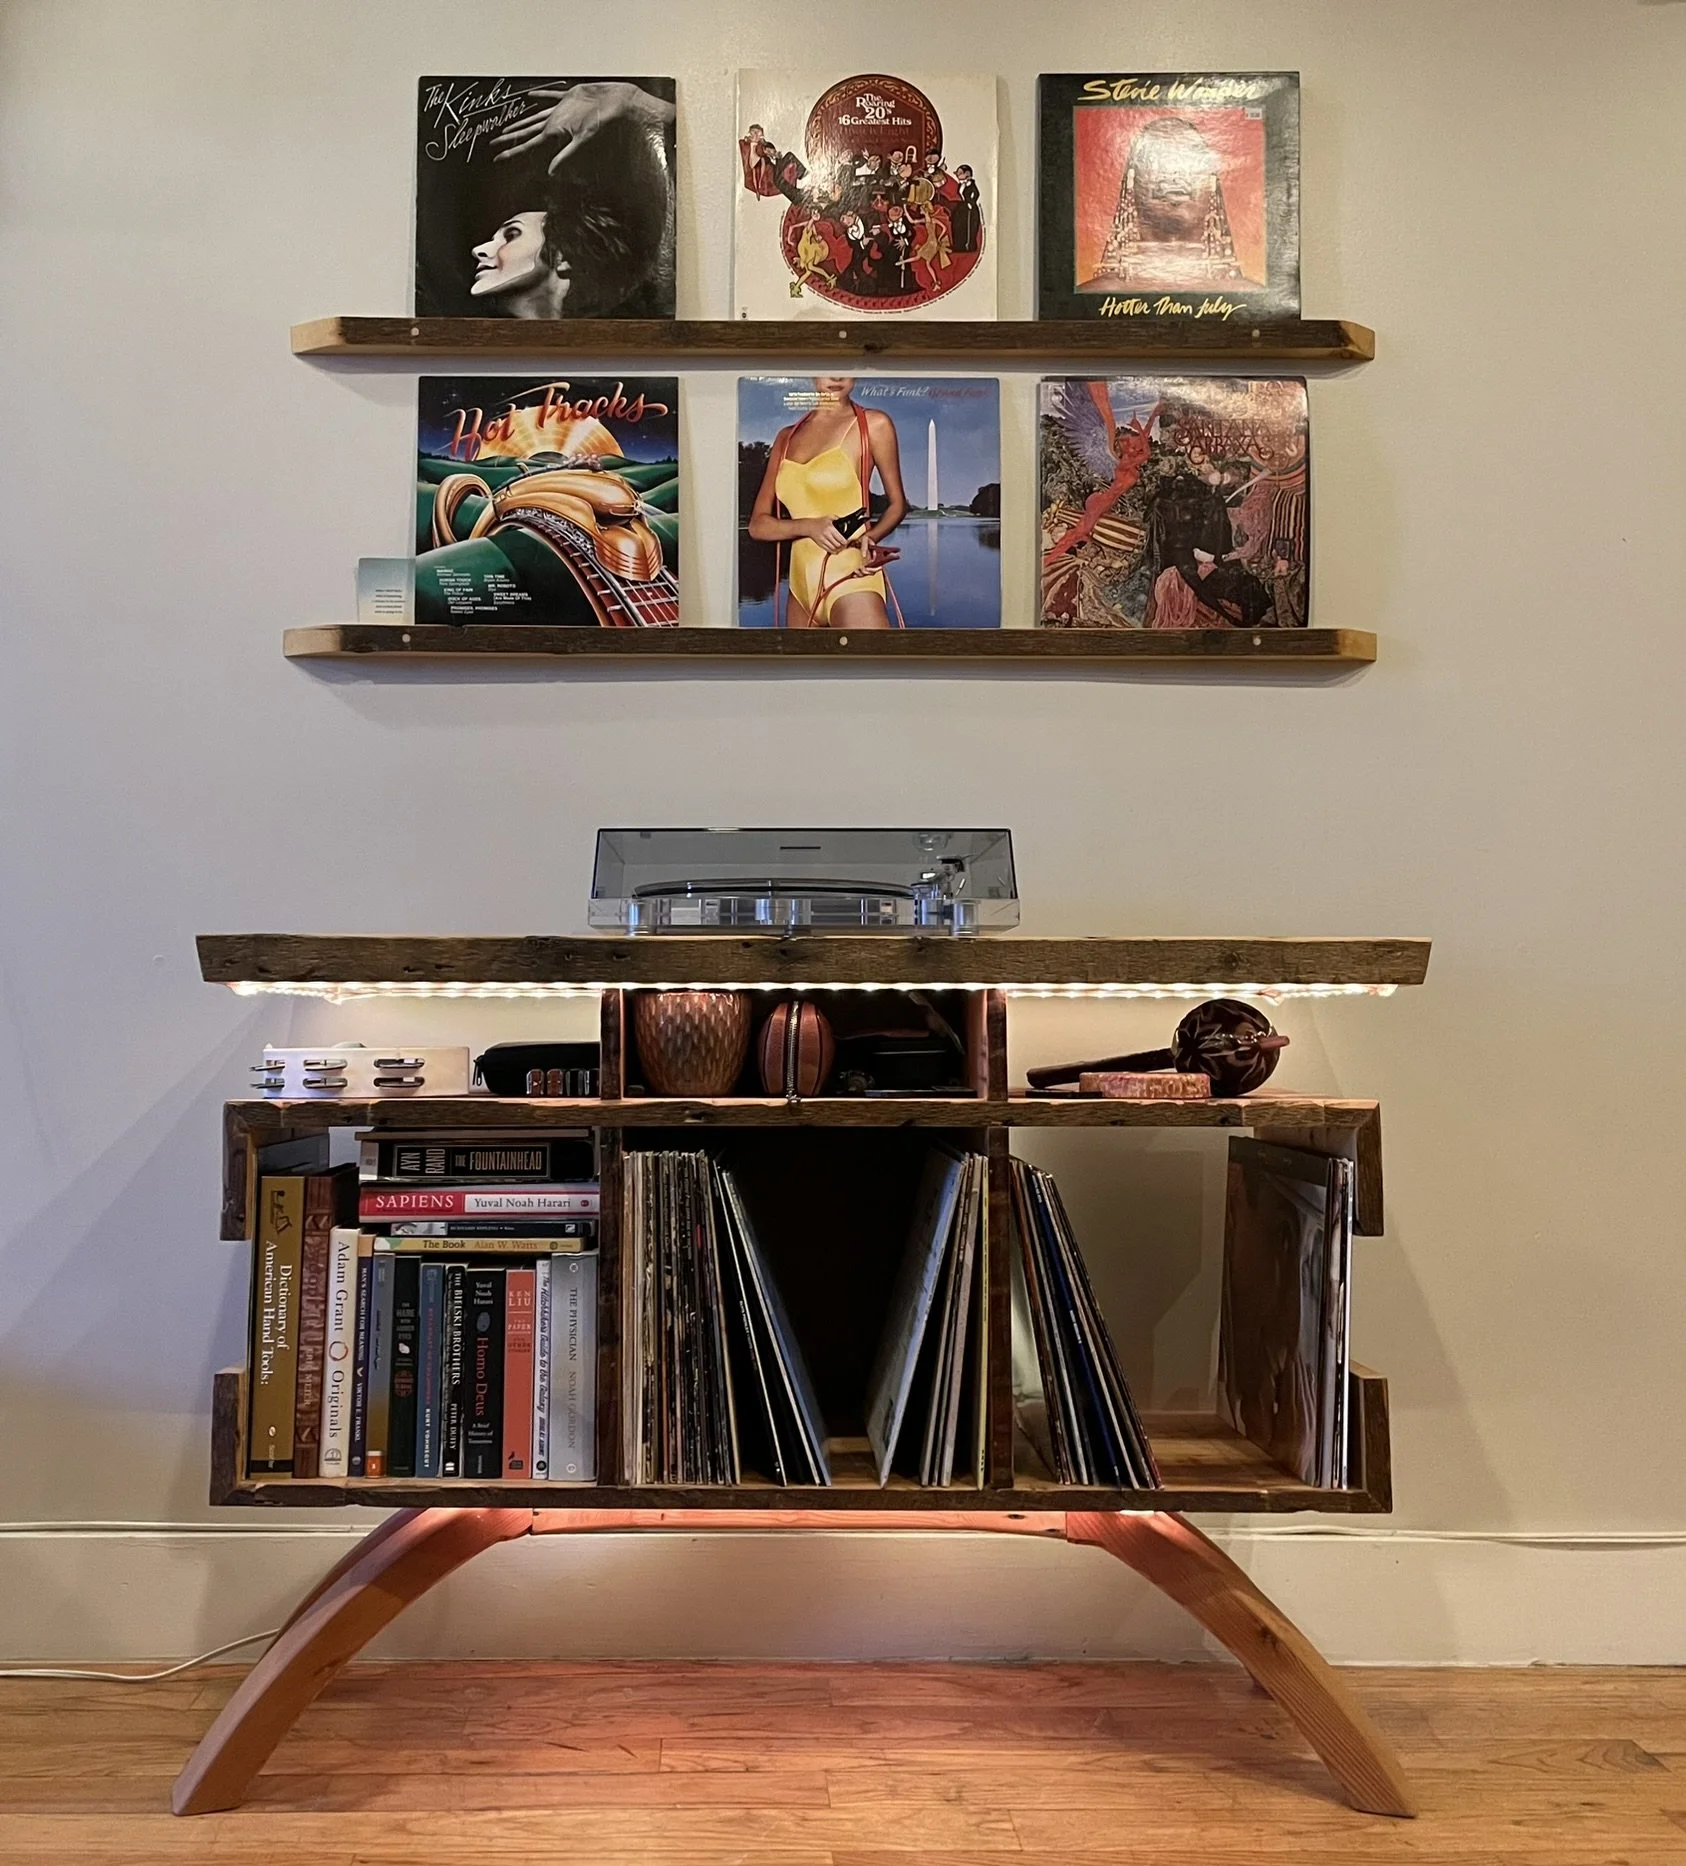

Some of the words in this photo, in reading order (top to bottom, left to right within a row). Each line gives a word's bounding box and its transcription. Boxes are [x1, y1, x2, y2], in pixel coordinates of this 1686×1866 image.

[424, 83, 444, 112] The
[856, 97, 895, 109] Roaring
[863, 93, 882, 101] The
[1077, 78, 1161, 101] Stevie
[1167, 77, 1260, 102] Wonder
[425, 101, 538, 163] Sleepwalker
[838, 114, 851, 126] 16
[851, 116, 890, 125] Greatest
[892, 117, 912, 126] Hits
[1098, 296, 1151, 317] Hotter
[1153, 295, 1193, 316] Than
[1194, 295, 1247, 321] July
[861, 384, 895, 397] What's
[896, 385, 929, 397] Funk?
[443, 403, 522, 461] Hot
[494, 381, 669, 430] Tracks
[400, 1152, 421, 1171] AYN
[425, 1148, 446, 1174] RAND
[456, 1155, 466, 1168] THE
[469, 1151, 542, 1171] FOUNTAINHEAD
[375, 1194, 454, 1208] SAPIENS
[474, 1198, 504, 1208] Yuval
[506, 1198, 534, 1208] Noah
[536, 1198, 571, 1208] Harari
[423, 1240, 440, 1249] The
[442, 1240, 466, 1249] Book
[473, 1240, 495, 1249] Alan
[498, 1240, 510, 1249] W.
[511, 1240, 538, 1250] Watts
[263, 1240, 277, 1306] American
[336, 1241, 350, 1284] Adam
[454, 1272, 462, 1286] THE
[275, 1264, 292, 1333] Dictionary
[334, 1289, 348, 1332] Grant
[453, 1289, 462, 1326] BIELSKI
[508, 1298, 532, 1306] LIU
[569, 1288, 578, 1307] THE
[262, 1308, 275, 1344] Hand
[358, 1316, 366, 1330] FOR
[569, 1309, 578, 1361] PHYSICIAN
[277, 1335, 290, 1350] of
[358, 1331, 366, 1361] MEANING
[540, 1334, 549, 1358] Guide
[260, 1346, 276, 1386] Tools:
[451, 1330, 462, 1385] BROTHERS
[476, 1337, 488, 1379] Homo
[540, 1359, 548, 1368] to
[539, 1368, 548, 1382] the
[568, 1371, 576, 1400] NOAH
[327, 1370, 344, 1438] Originals
[475, 1383, 488, 1416] Deus
[536, 1384, 548, 1413] Galaxy
[450, 1403, 458, 1424] PETER
[567, 1402, 576, 1448] GORDON
